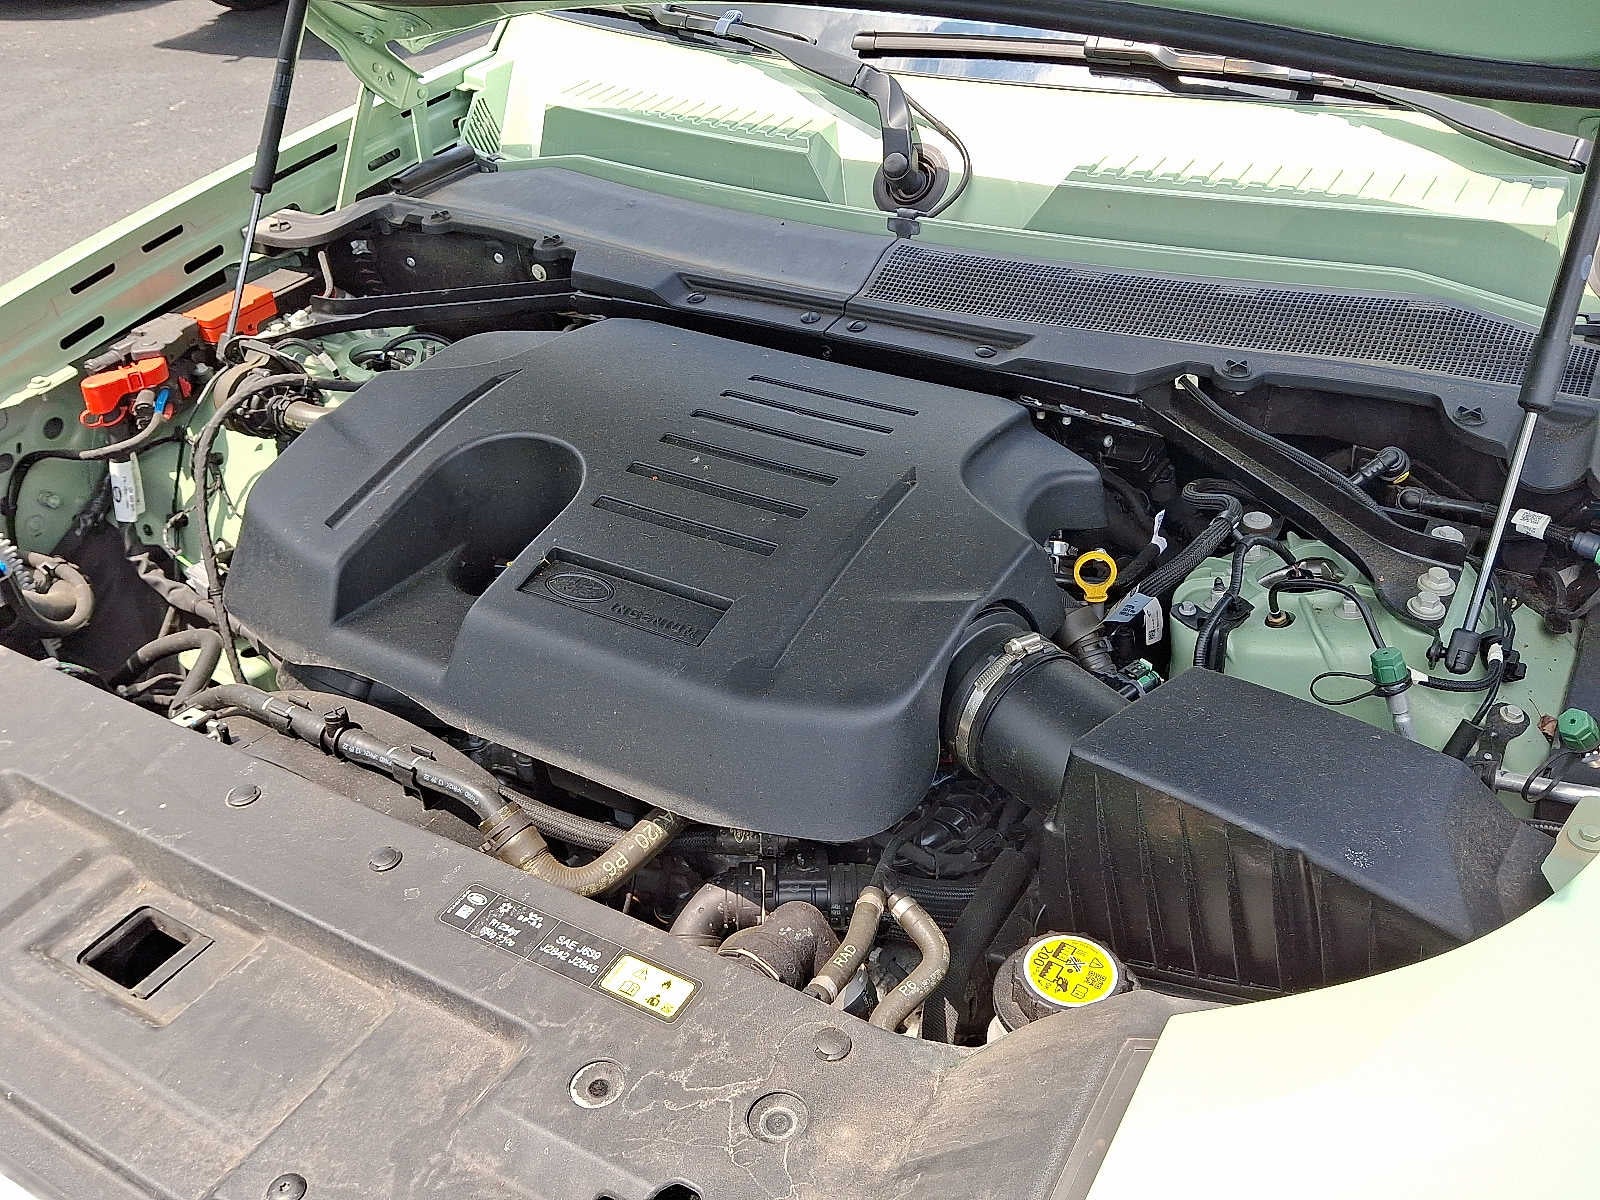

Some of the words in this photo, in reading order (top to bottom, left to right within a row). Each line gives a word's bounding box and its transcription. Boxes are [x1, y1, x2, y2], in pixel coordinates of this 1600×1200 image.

[539, 943, 570, 961] J2842
[555, 935, 578, 950] SAE
[576, 944, 602, 960] J639
[833, 945, 857, 968] RAD
[899, 980, 917, 997] P6
